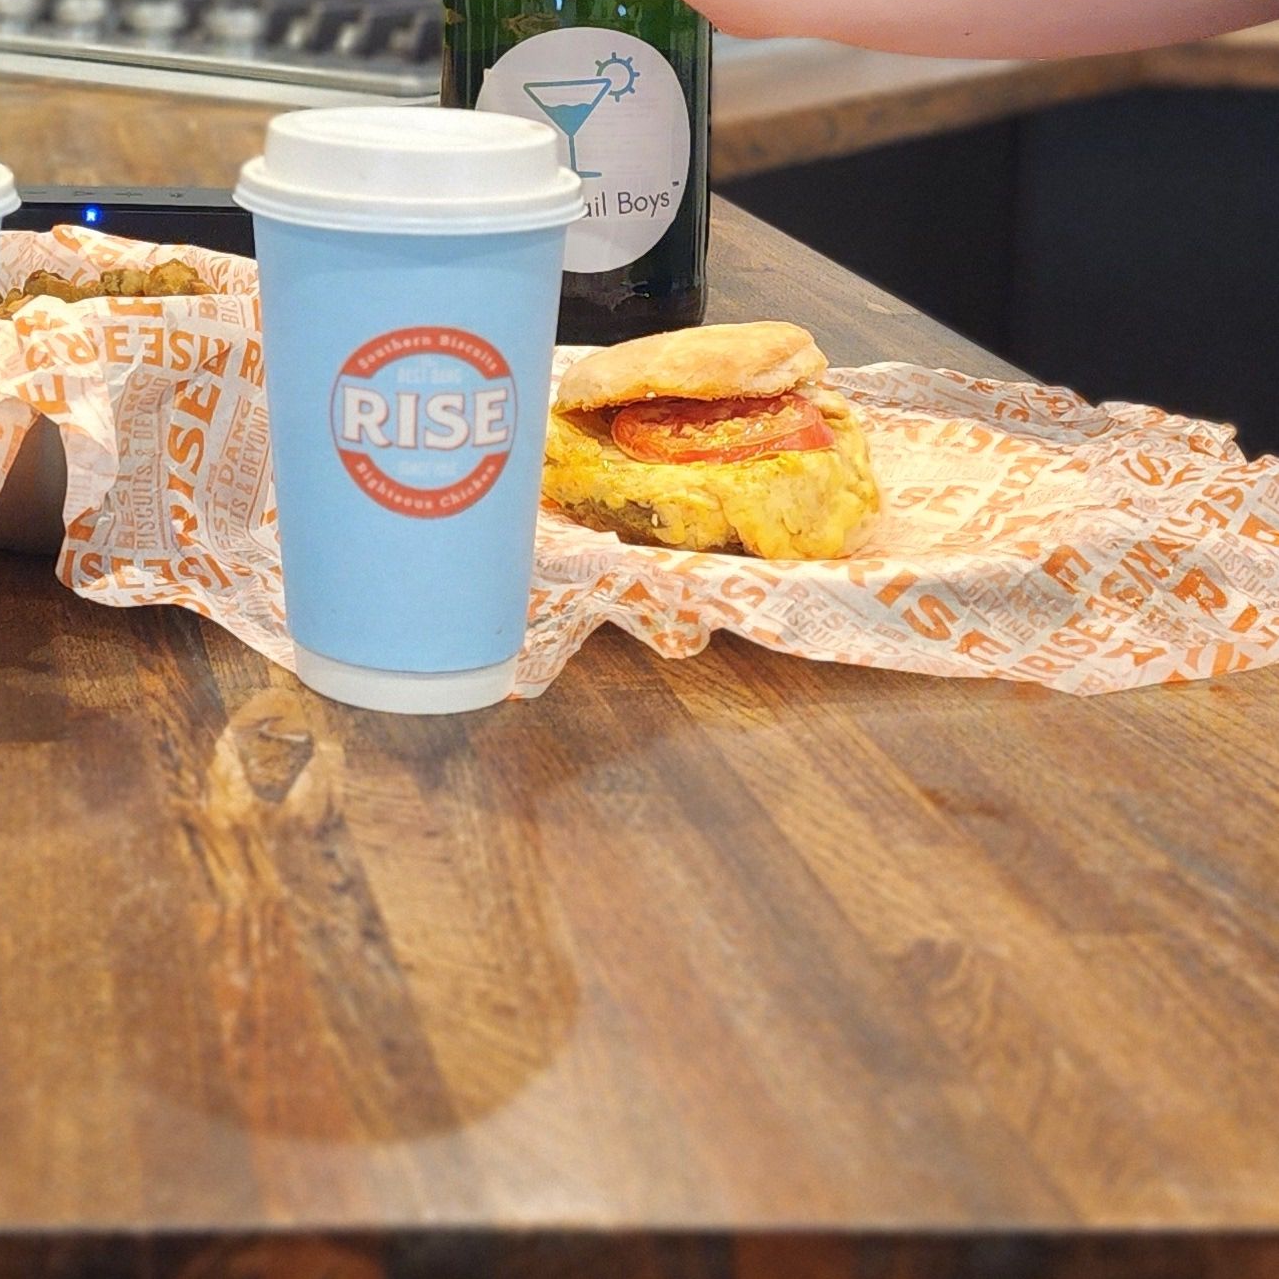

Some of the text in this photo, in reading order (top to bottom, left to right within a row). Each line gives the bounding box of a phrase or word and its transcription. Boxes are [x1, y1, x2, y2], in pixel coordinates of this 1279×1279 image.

[617, 191, 670, 218] Boys
[357, 333, 498, 372] Southern Biscuits
[341, 384, 510, 451] RISE
